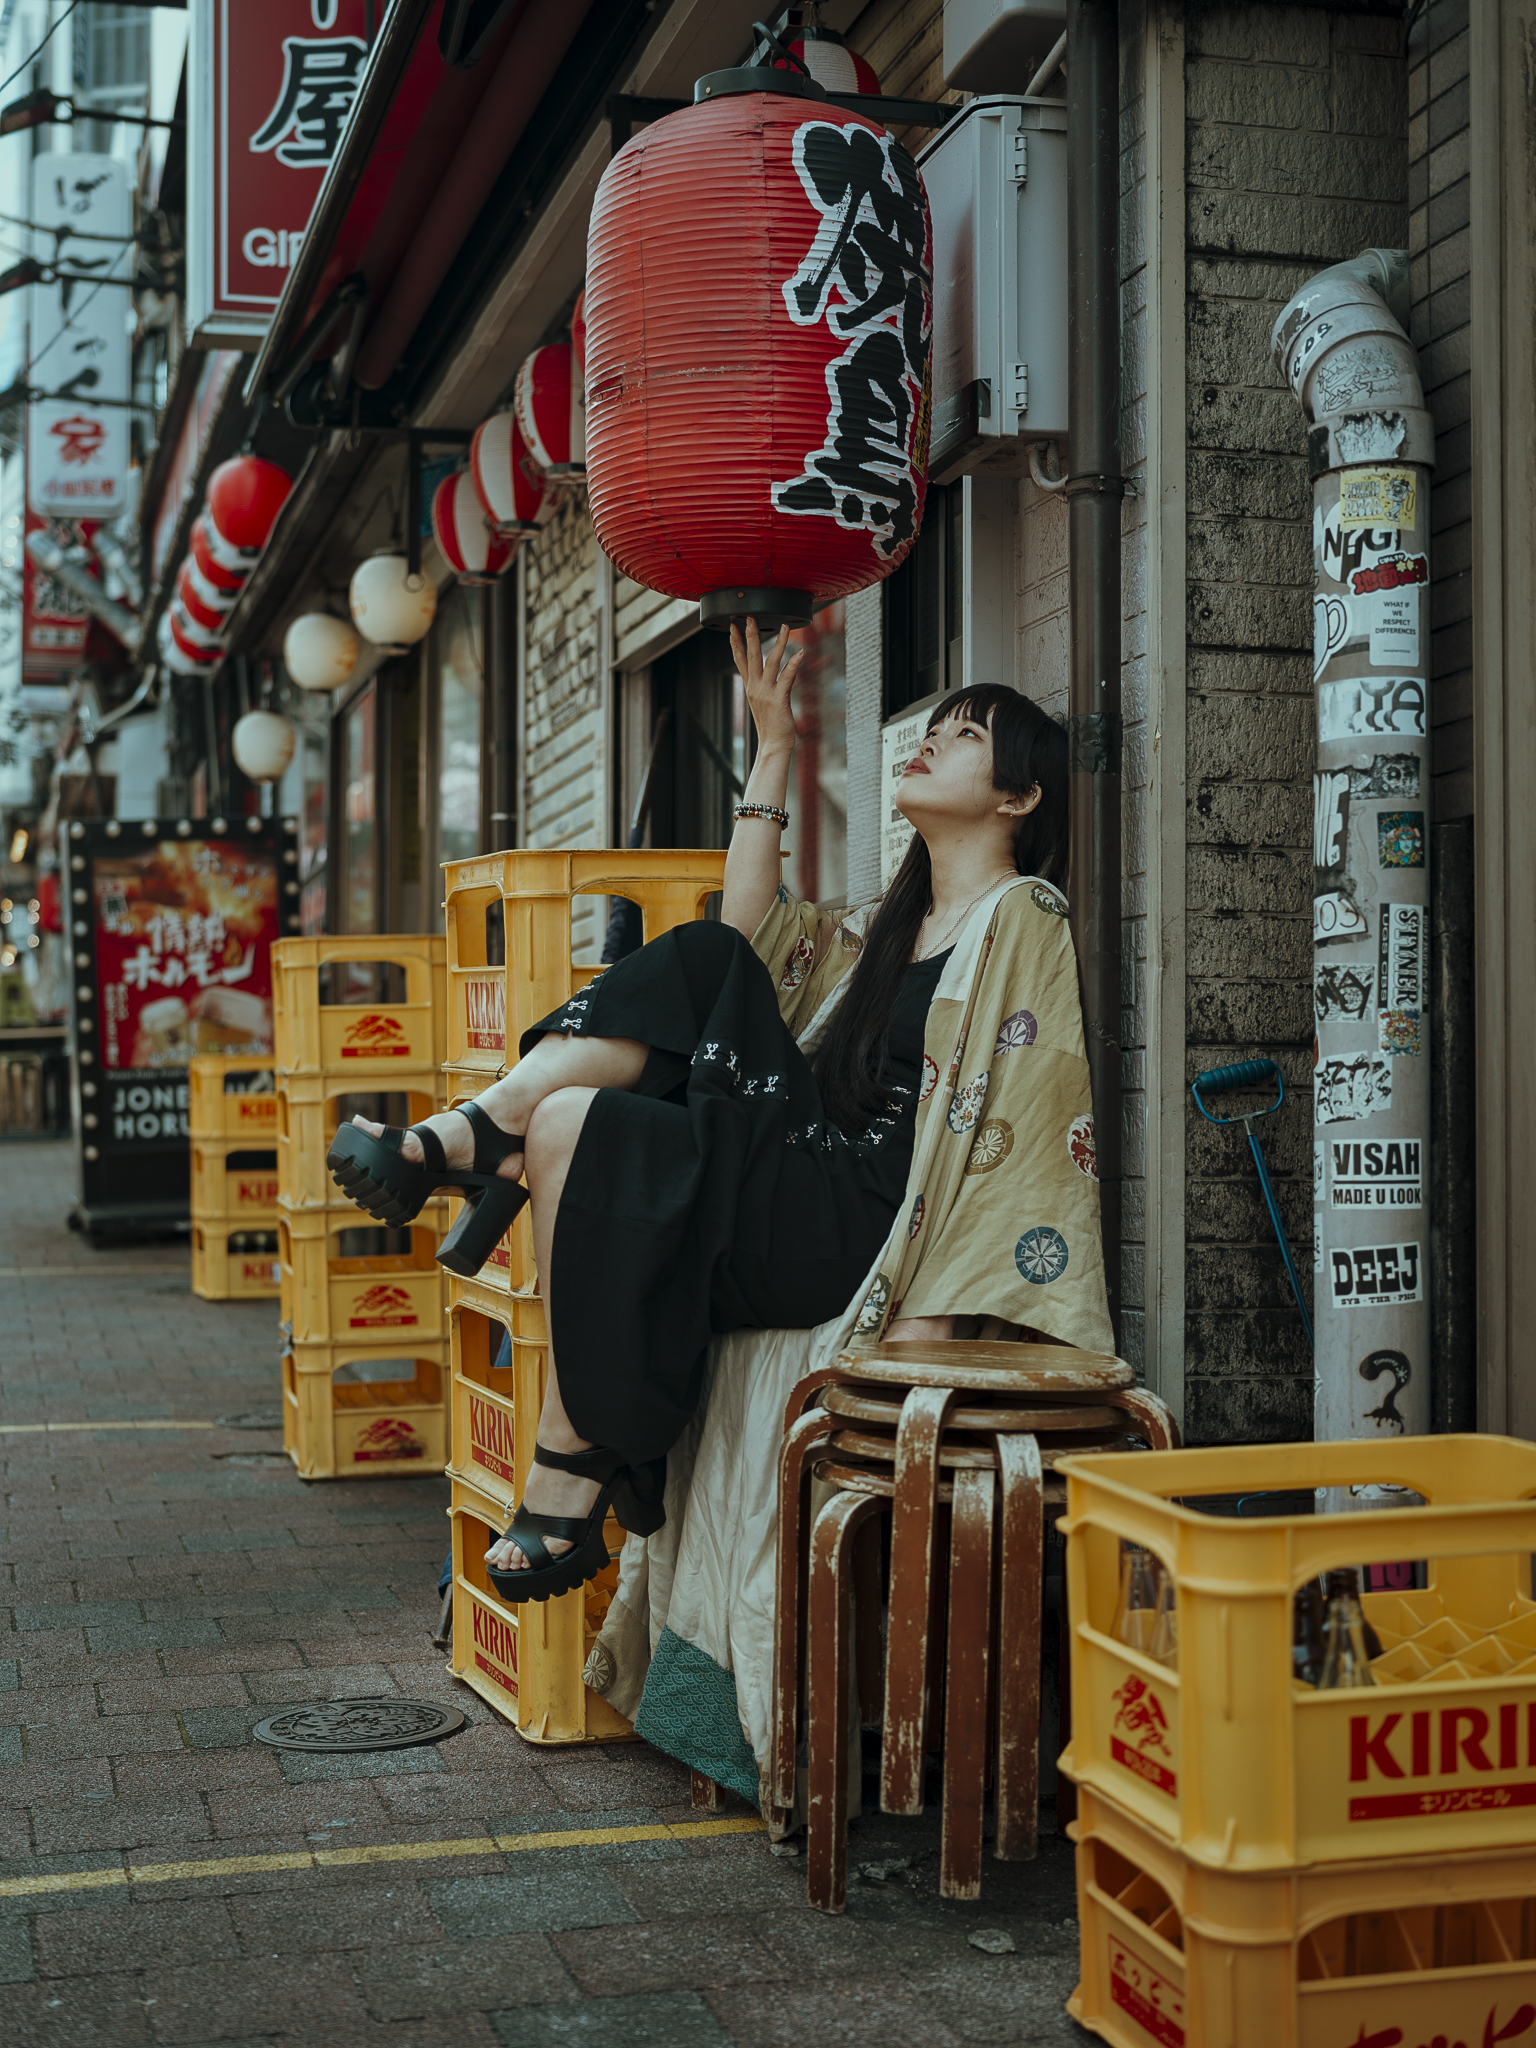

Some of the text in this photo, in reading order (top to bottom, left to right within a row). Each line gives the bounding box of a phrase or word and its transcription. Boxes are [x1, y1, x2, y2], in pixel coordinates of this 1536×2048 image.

[122, 942, 256, 991] ホルモン
[1333, 1142, 1420, 1176] VISAH
[1333, 1187, 1421, 1205] MADE U LOOK
[1331, 1244, 1419, 1296] DEEJ
[469, 1394, 514, 1463] KIRIN
[473, 1601, 518, 1674] KIRIN
[1349, 1702, 1536, 1782] KIRI
[1419, 1788, 1512, 1813] キリンビール
